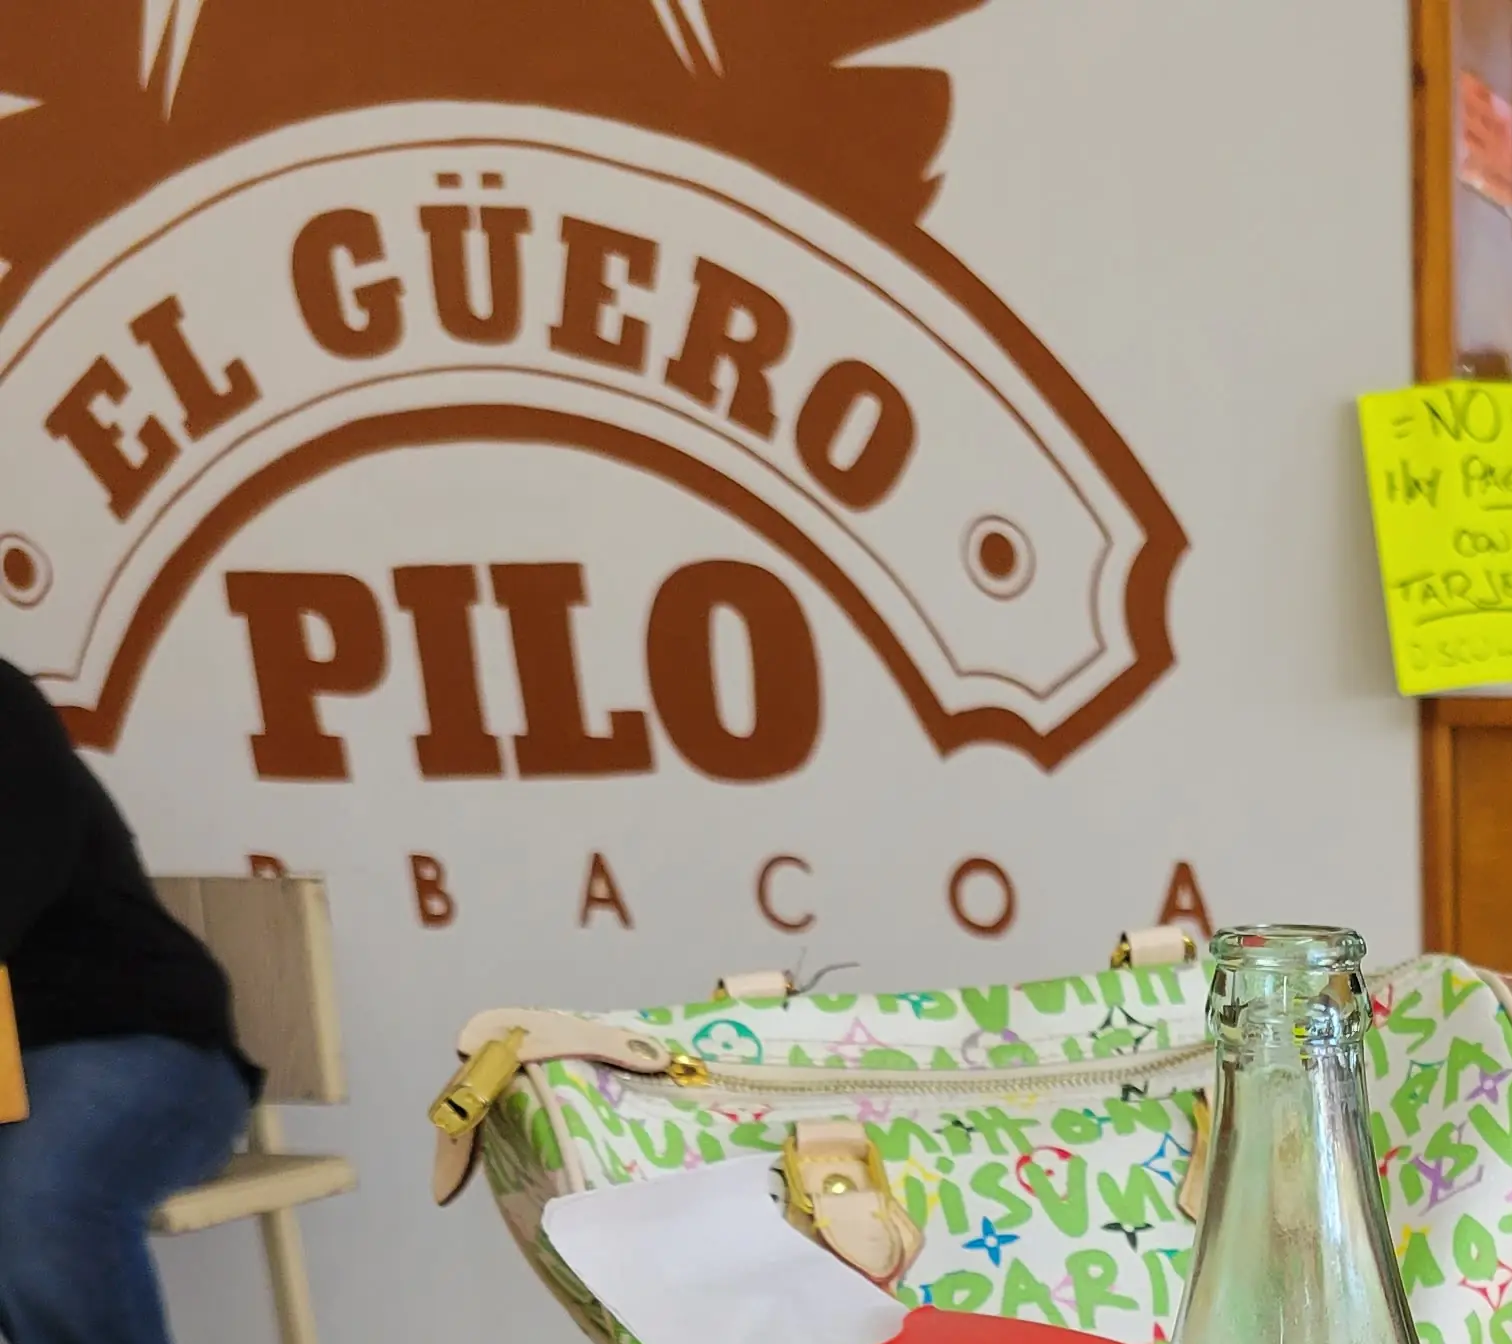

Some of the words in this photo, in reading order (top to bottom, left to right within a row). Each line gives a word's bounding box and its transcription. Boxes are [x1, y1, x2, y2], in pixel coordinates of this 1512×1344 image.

[44, 293, 262, 523] EL
[292, 172, 918, 513] GÜERO
[1423, 388, 1502, 443] NO
[1385, 458, 1442, 508] HAY
[1454, 529, 1511, 557] CON
[225, 558, 822, 783] PILO
